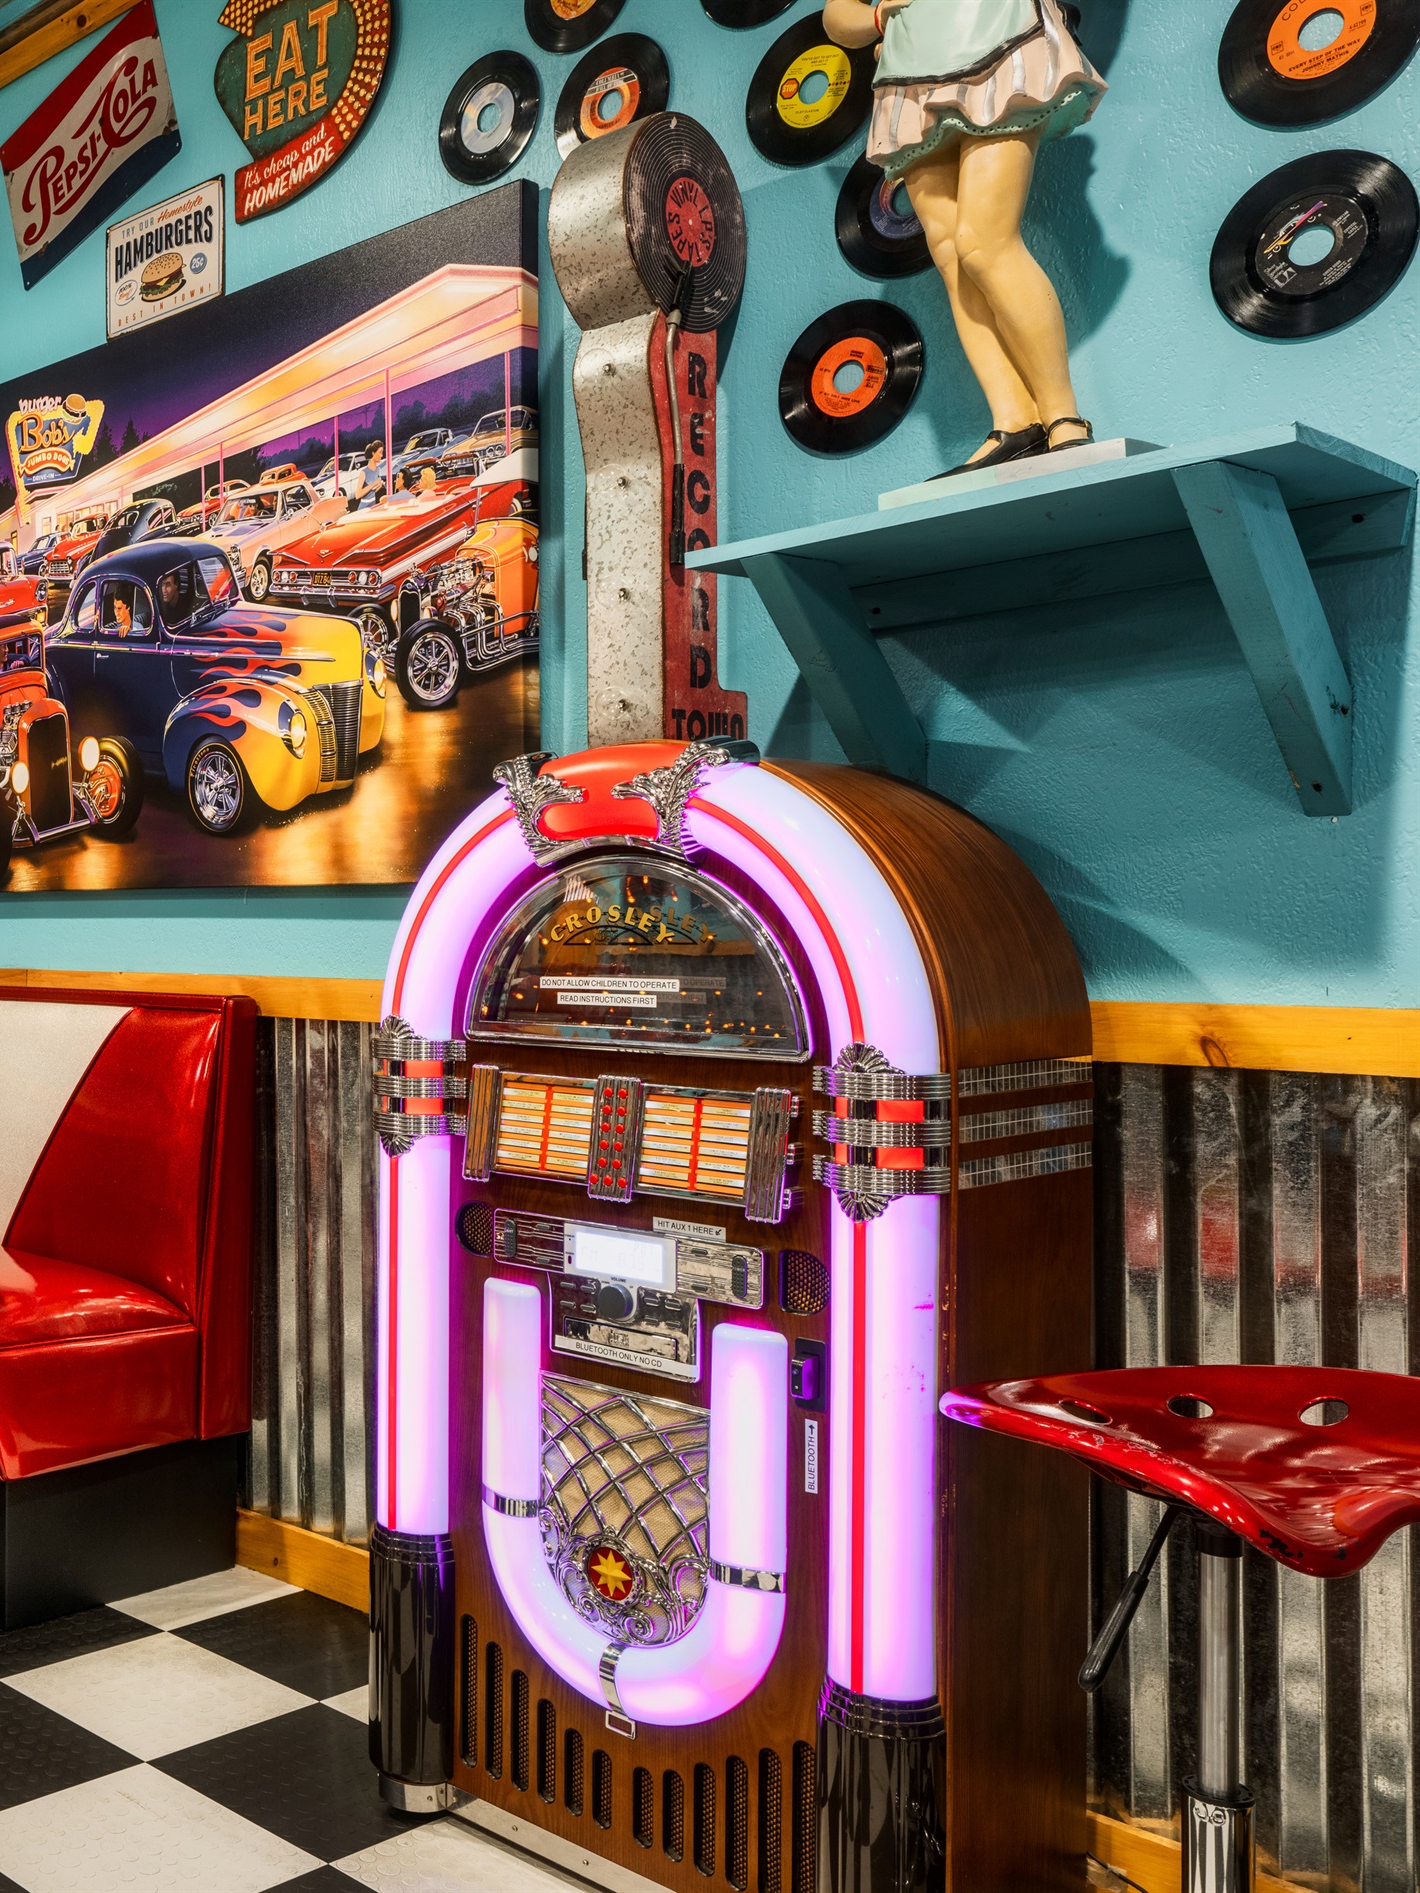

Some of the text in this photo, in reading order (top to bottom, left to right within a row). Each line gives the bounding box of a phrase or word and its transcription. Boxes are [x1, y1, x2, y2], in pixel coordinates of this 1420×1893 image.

[244, 0, 338, 102] EAT
[1289, 62, 1307, 72] EVERY
[1308, 54, 1323, 63] STEP
[1347, 38, 1361, 47] WAY
[1302, 50, 1349, 73] JOHNNY MATHIS
[243, 68, 329, 141] HERE
[244, 123, 327, 189] It's cheap and
[244, 136, 335, 216] HOMEMADE
[669, 180, 699, 209] VINYL
[121, 195, 204, 240] TRY OUR Homestyle
[115, 205, 214, 283] HAMBURGERS
[668, 212, 703, 263] TAPES
[191, 256, 205, 270] 25¢
[118, 283, 212, 327] BEST IN TOWN!
[18, 395, 62, 415] burger
[18, 413, 76, 453] Bob's
[27, 452, 52, 468] JUMBO
[32, 473, 55, 482] DRIVE-IN
[550, 904, 675, 945] CROSLEY
[566, 979, 591, 987] ALLOW
[591, 980, 628, 988] CHILDREN
[640, 981, 677, 989] OPERATE
[580, 995, 632, 1003] INSTRUCTIONS
[632, 997, 655, 1005] FIRST
[658, 1220, 670, 1228] HIT
[671, 1222, 686, 1231] AUX
[693, 1226, 714, 1235] HERE
[575, 1342, 618, 1358] BLUETOOTH
[618, 1352, 638, 1362] ONLY
[651, 1360, 662, 1368] CD
[807, 1436, 815, 1490] BLUETOOTH
